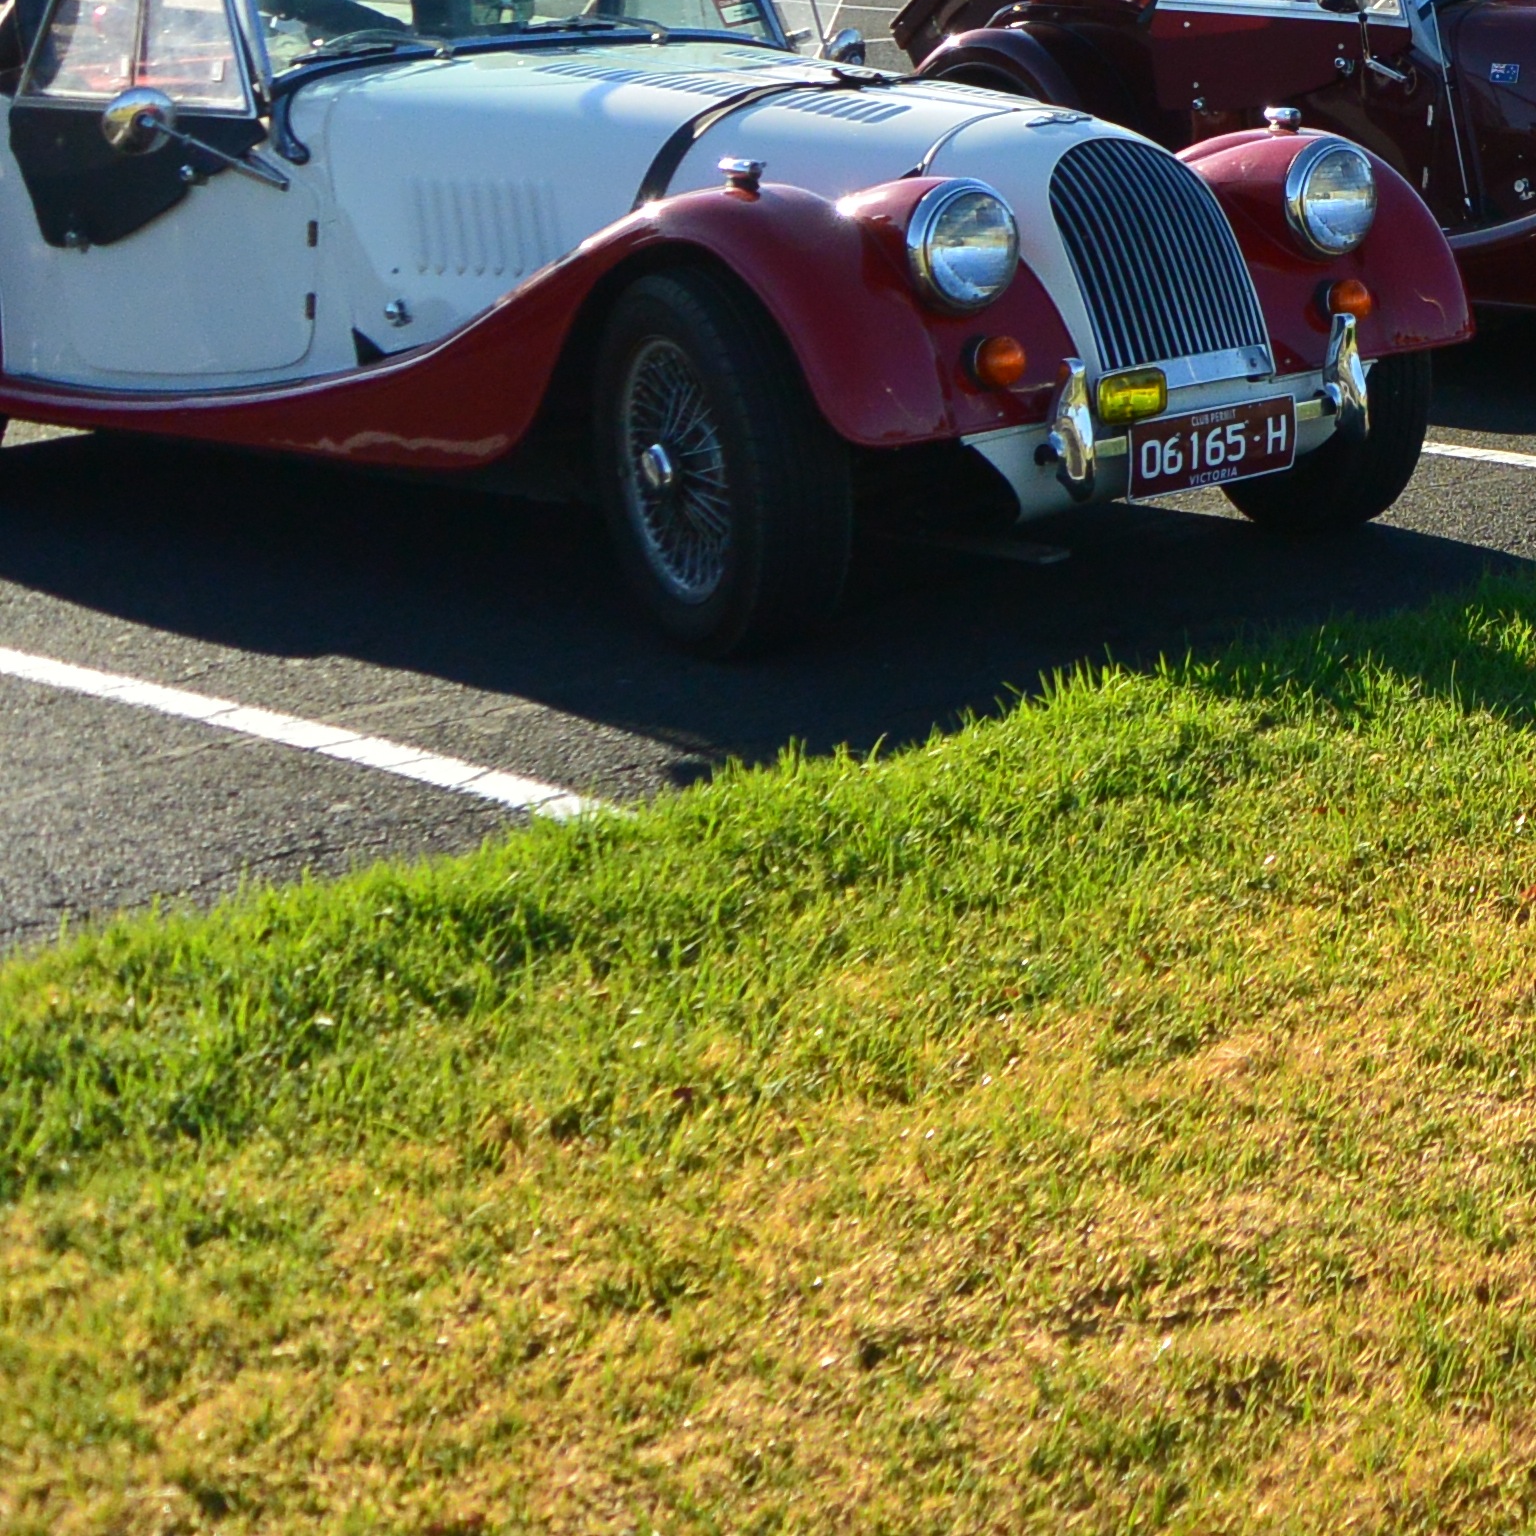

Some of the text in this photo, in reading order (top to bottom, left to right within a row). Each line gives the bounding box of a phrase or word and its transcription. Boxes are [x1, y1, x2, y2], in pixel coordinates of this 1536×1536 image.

[1191, 409, 1237, 427] CLUB PERMIT
[1189, 466, 1238, 486] VICTORIA
